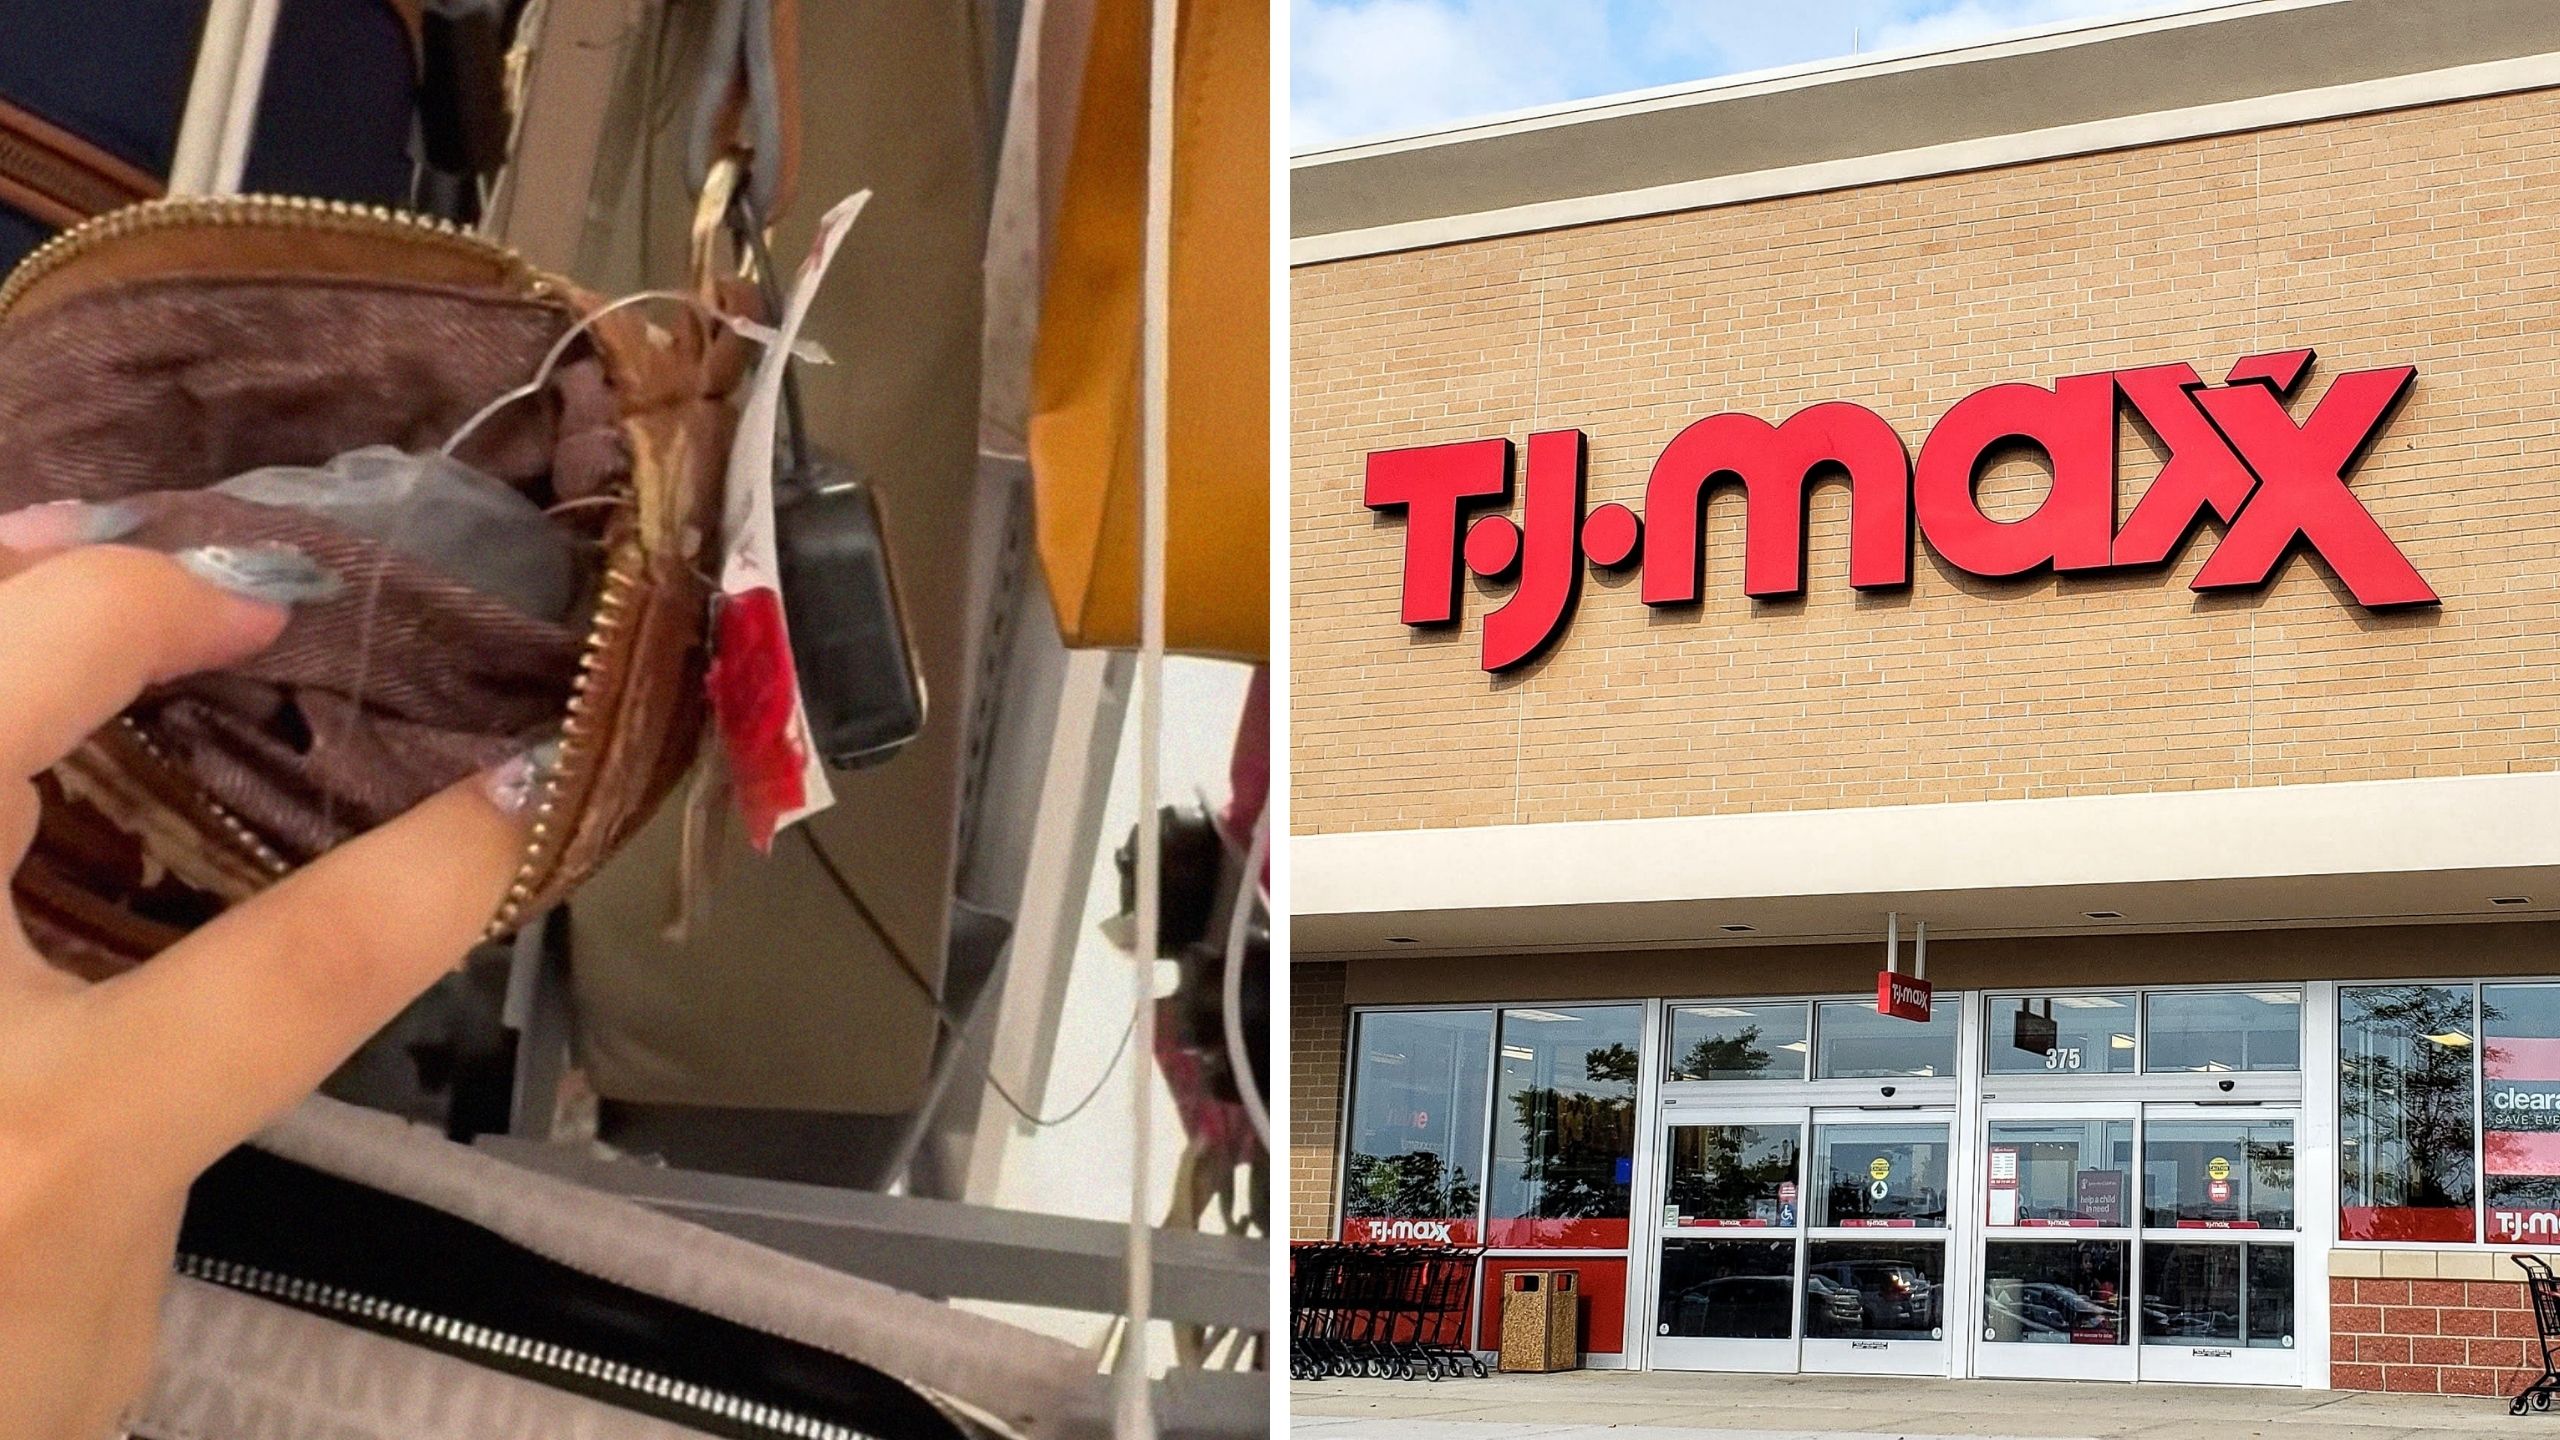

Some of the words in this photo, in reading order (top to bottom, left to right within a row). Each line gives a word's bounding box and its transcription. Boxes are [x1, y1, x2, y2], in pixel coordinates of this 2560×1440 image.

[2045, 1048, 2081, 1069] 375
[2495, 1114, 2529, 1125] SAVE
[2080, 1195, 2094, 1205] help
[2100, 1194, 2116, 1204] child
[2093, 1204, 2110, 1213] need
